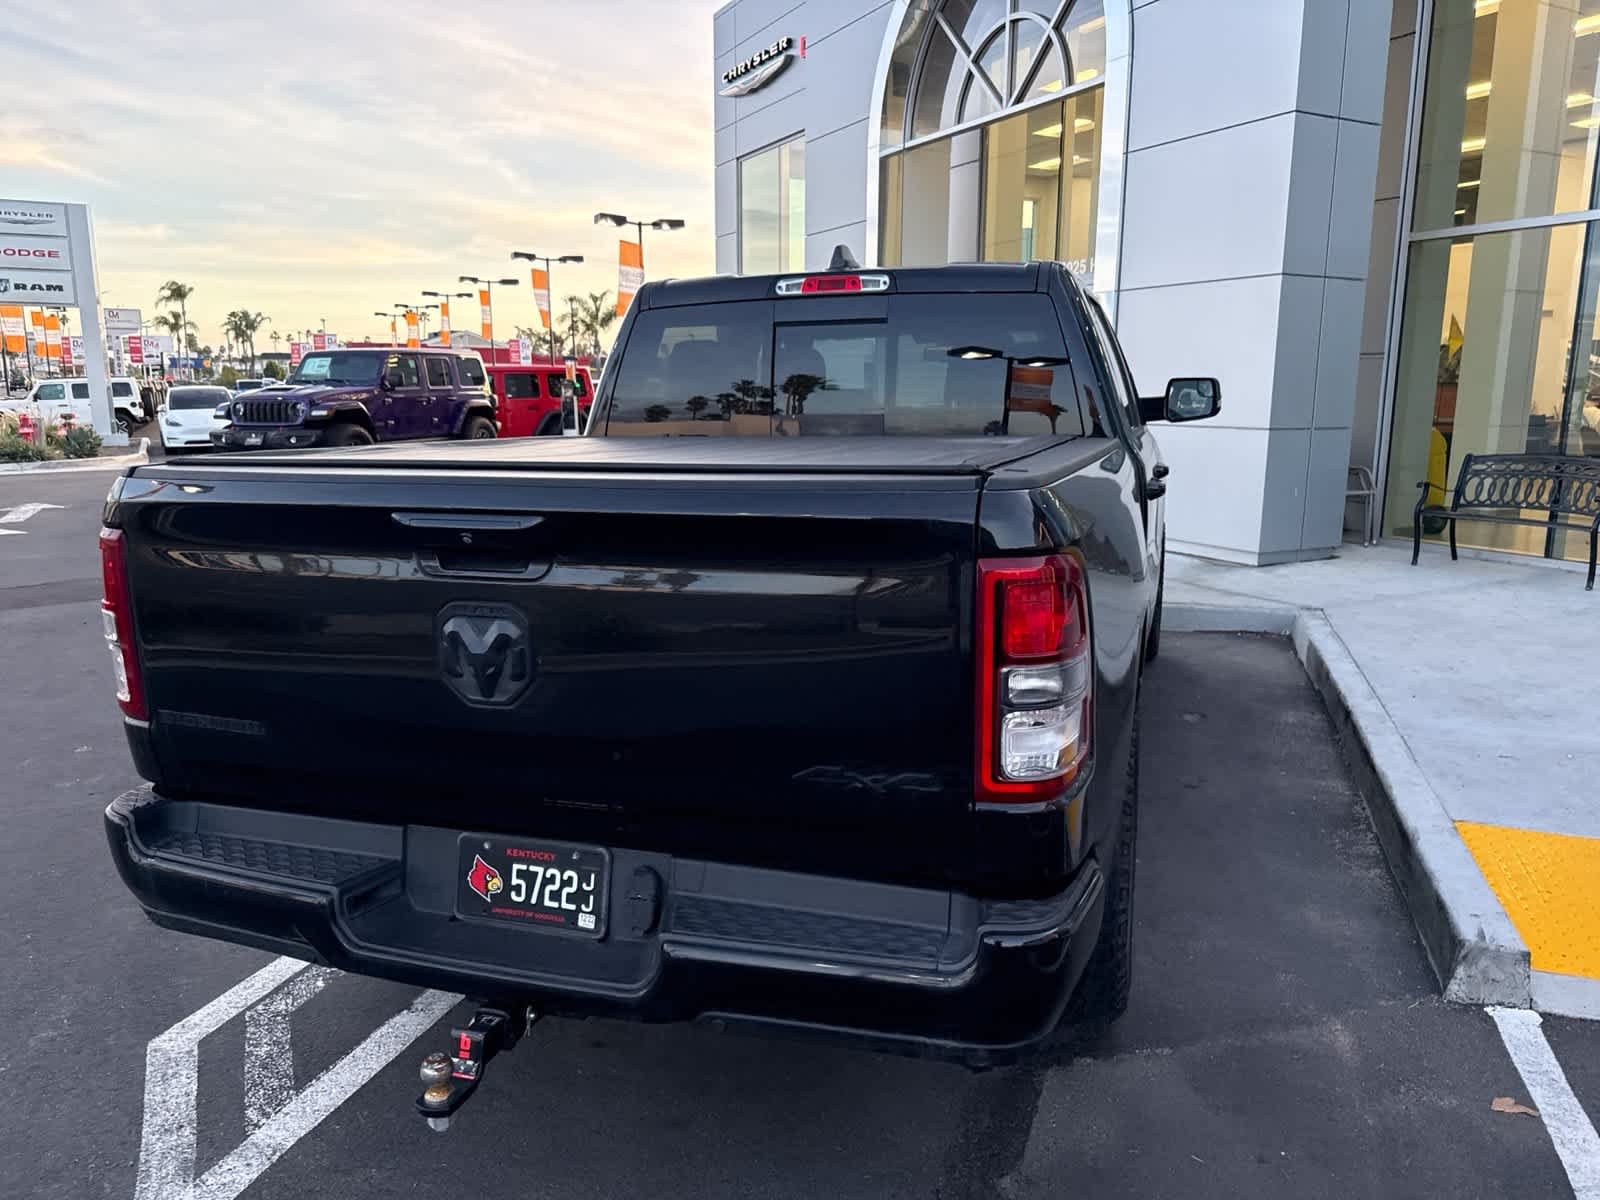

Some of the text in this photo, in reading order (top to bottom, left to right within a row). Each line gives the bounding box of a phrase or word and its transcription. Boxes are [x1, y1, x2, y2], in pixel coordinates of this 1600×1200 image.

[721, 36, 790, 83] CHRYSLER
[0, 248, 60, 259] ODGE
[14, 282, 65, 292] RAM
[506, 849, 556, 861] KENTUCKY
[511, 864, 578, 910] 5722
